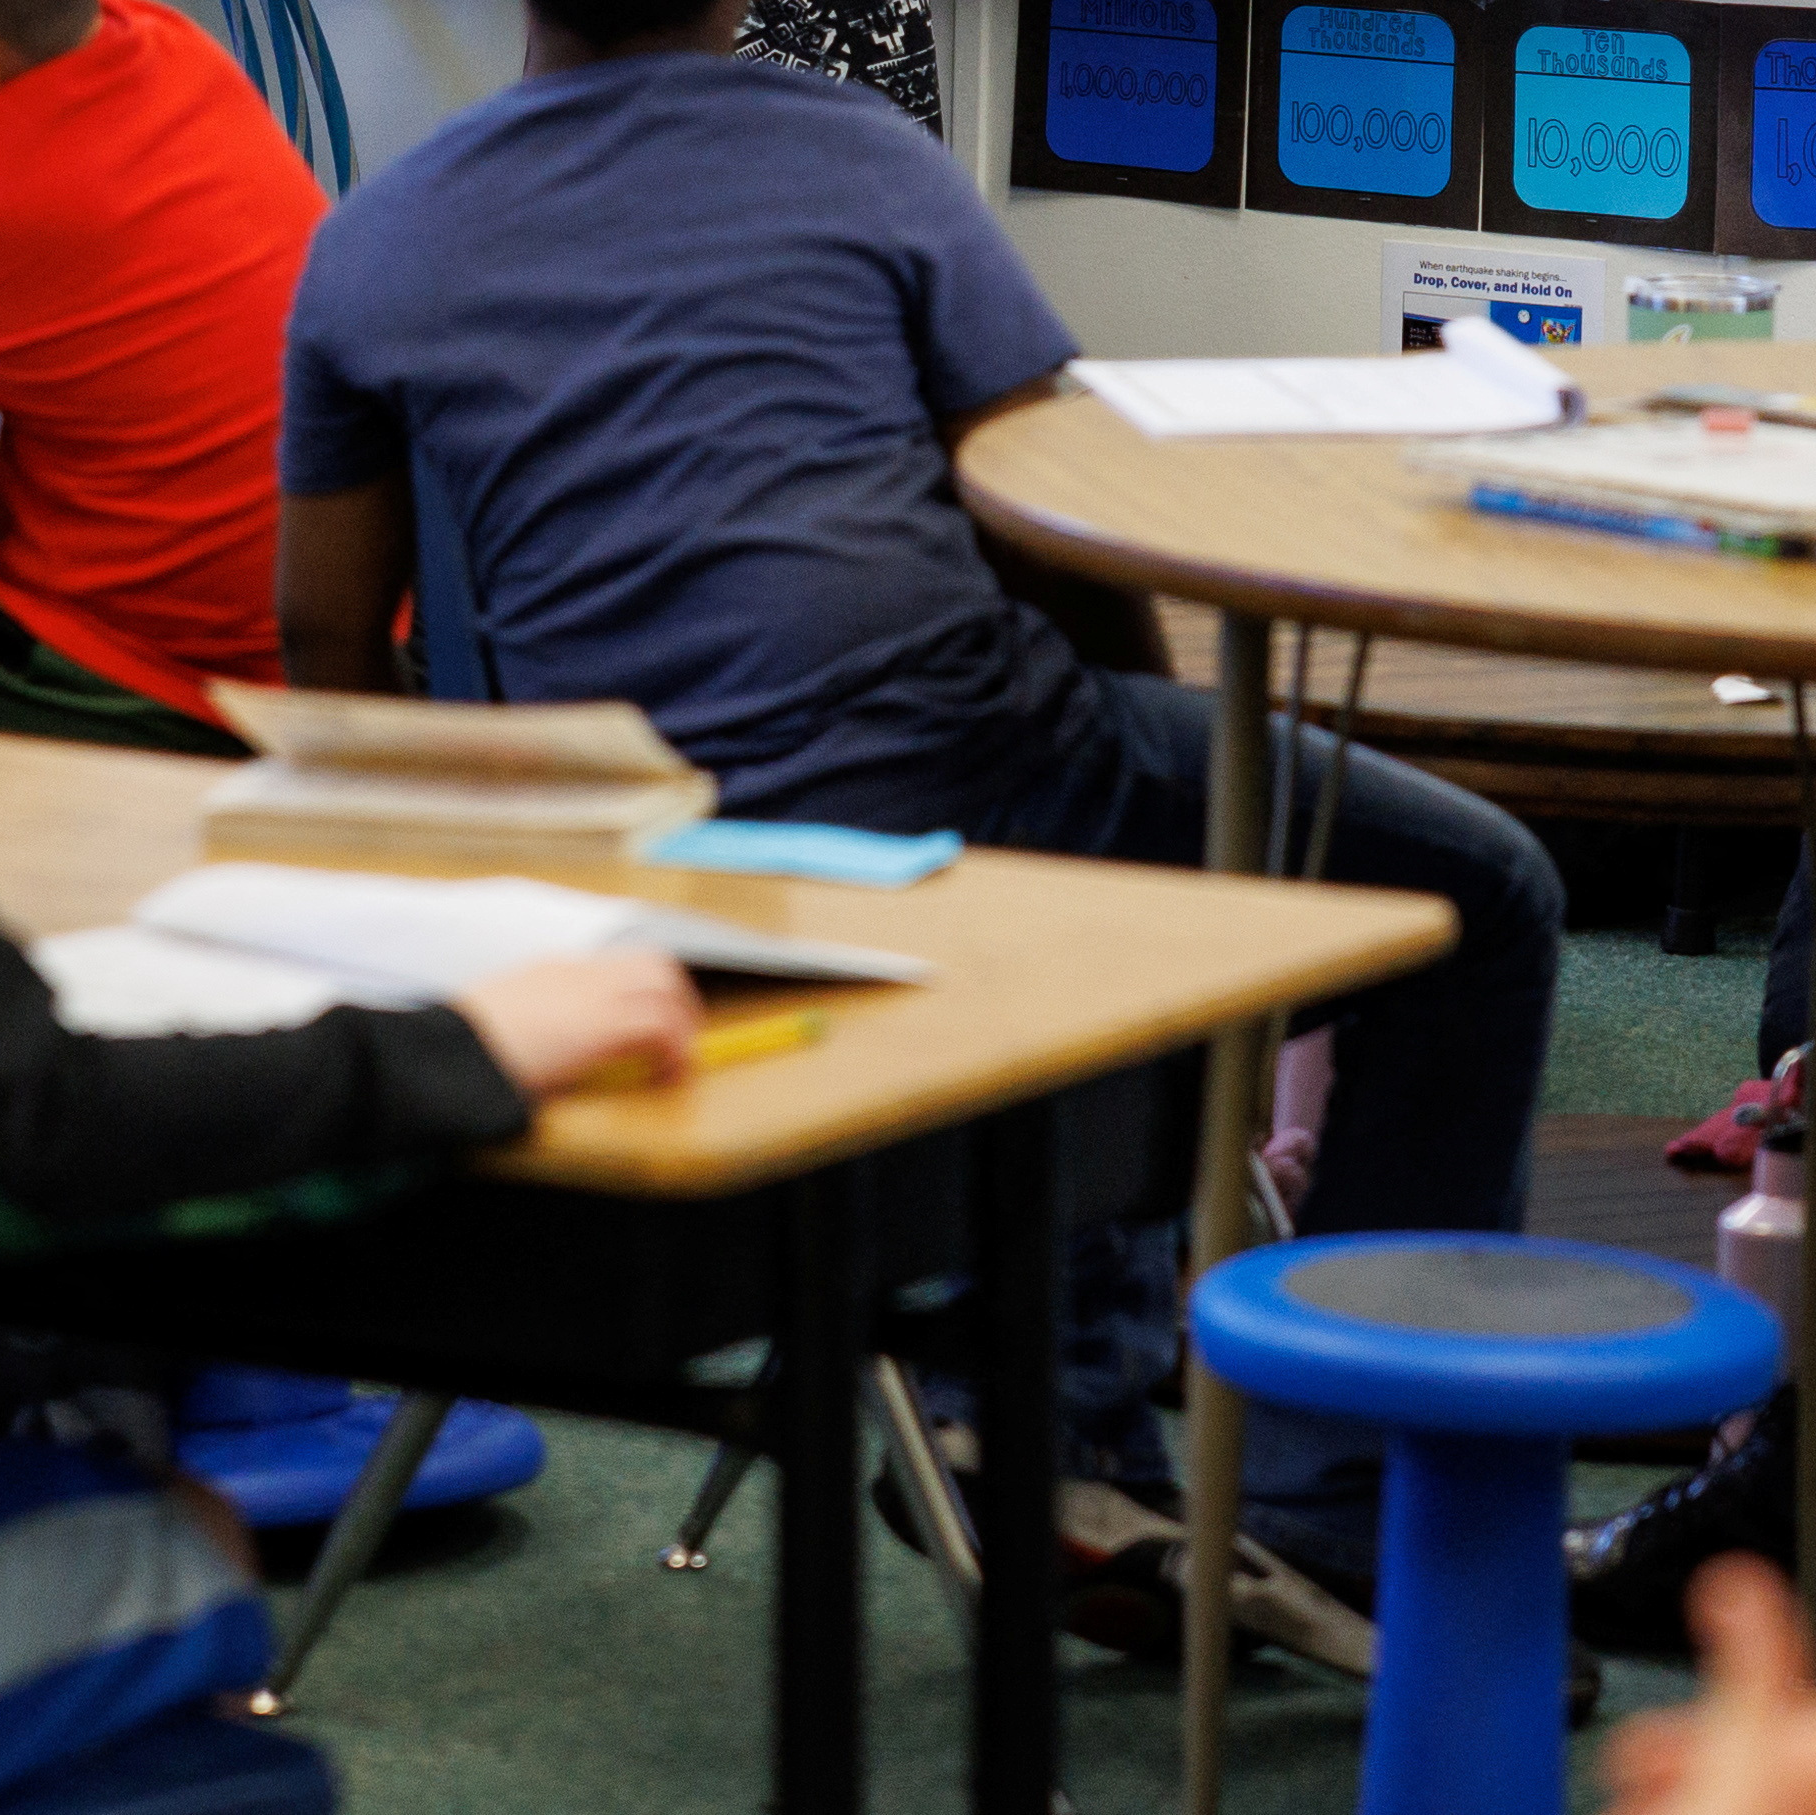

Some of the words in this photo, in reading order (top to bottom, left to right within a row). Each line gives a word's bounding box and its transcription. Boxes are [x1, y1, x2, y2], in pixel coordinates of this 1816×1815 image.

[1318, 7, 1417, 34] Hundred
[1307, 28, 1427, 59] Thousands
[1581, 31, 1626, 55] Ten
[1536, 49, 1669, 82] Thousands
[1059, 61, 1209, 110] 1,000,000
[1290, 101, 1446, 155] 100,000
[1526, 117, 1683, 178] 10,000
[1414, 273, 1448, 288] Drop,
[1451, 277, 1490, 293] Cover,
[1494, 282, 1517, 293] and
[1521, 284, 1551, 296] Hold
[1555, 286, 1572, 298] On
[1420, 261, 1443, 271] When
[1446, 264, 1494, 276] earthquake
[1496, 268, 1529, 279] shaking
